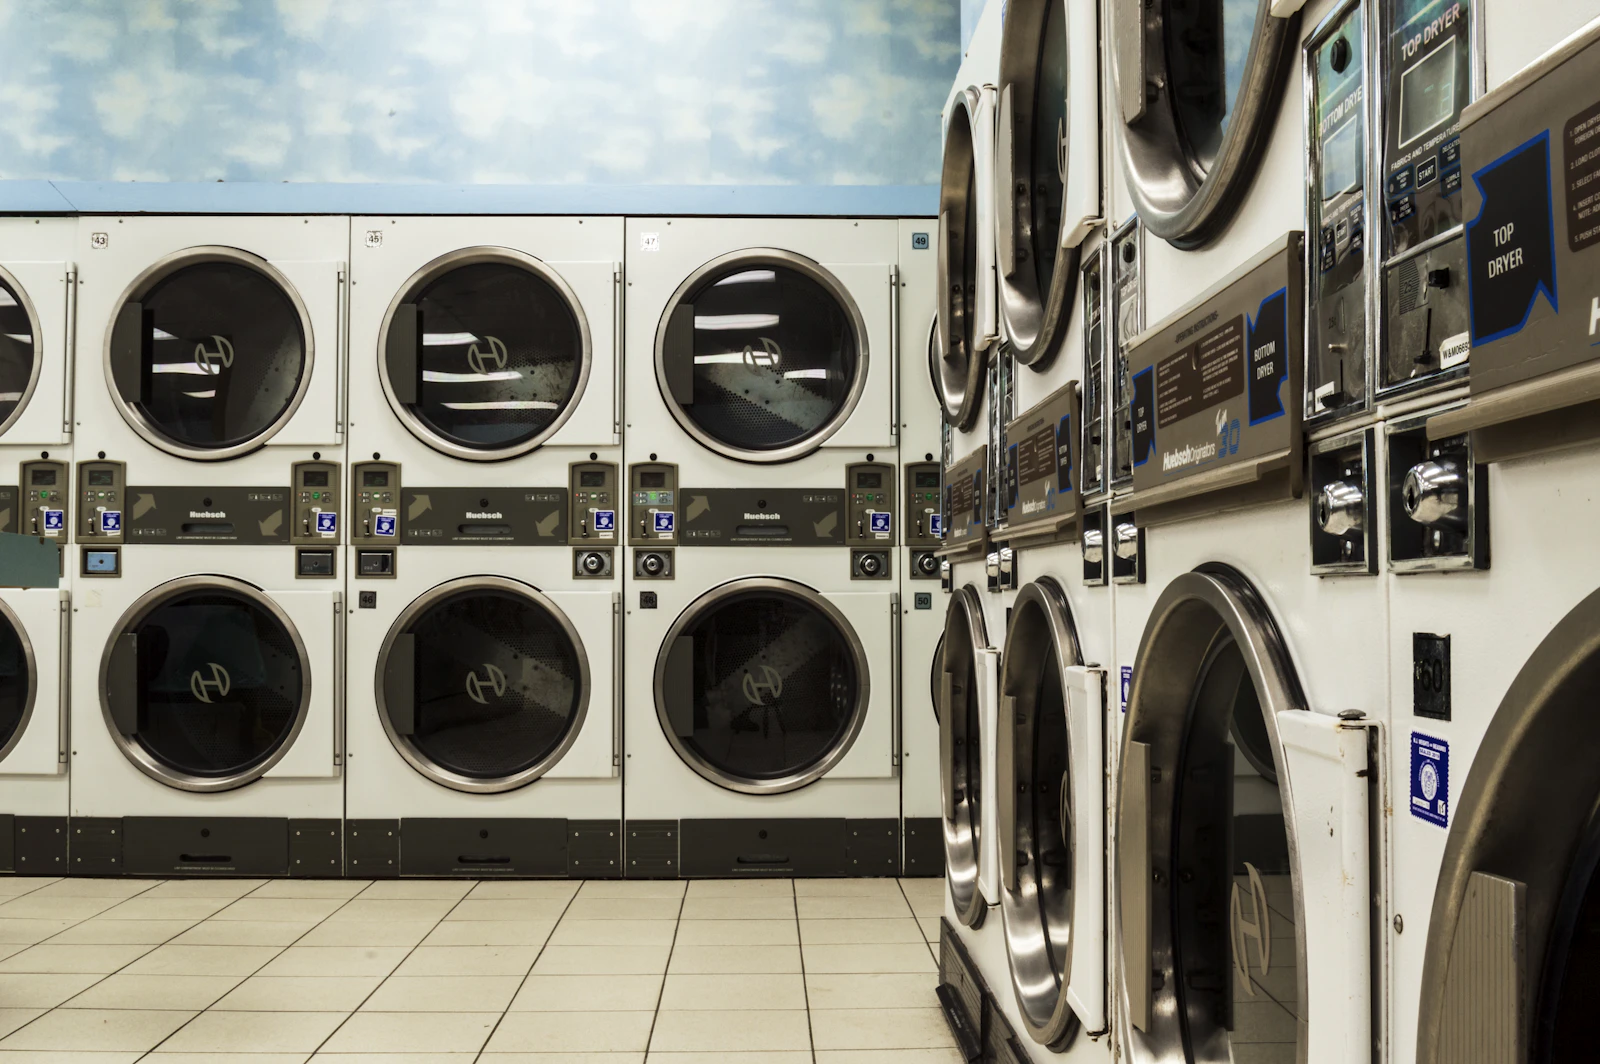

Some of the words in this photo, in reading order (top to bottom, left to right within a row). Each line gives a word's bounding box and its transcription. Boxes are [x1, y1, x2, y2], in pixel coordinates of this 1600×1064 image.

[1401, 33, 1422, 61] TOP
[1424, 2, 1460, 45] DRYER
[1345, 84, 1362, 114] DRYE
[1573, 122, 1587, 136] OPEN
[1391, 153, 1412, 171] FABRICS
[1411, 146, 1423, 159] AND
[1423, 122, 1460, 151] TEMPERATURE
[1575, 154, 1588, 167] LOAD
[1418, 165, 1434, 181] START
[1576, 174, 1593, 188] SELECT
[1577, 195, 1594, 210] INSERT
[1578, 207, 1592, 220] NOTE:
[94, 236, 106, 245] 43
[368, 235, 380, 243] 45
[644, 237, 656, 245] 47
[915, 237, 926, 245] 49
[1493, 222, 1514, 247] TOP
[1580, 228, 1592, 241] PUSH
[1488, 247, 1523, 279] DRYER
[1254, 340, 1275, 362] BOTTOM
[1256, 361, 1274, 380] DRYER
[189, 511, 226, 519] Huebsch
[465, 511, 503, 519] Huebsch
[743, 512, 781, 520] Huebsch
[918, 596, 929, 605] 50
[1421, 658, 1443, 693] 60
